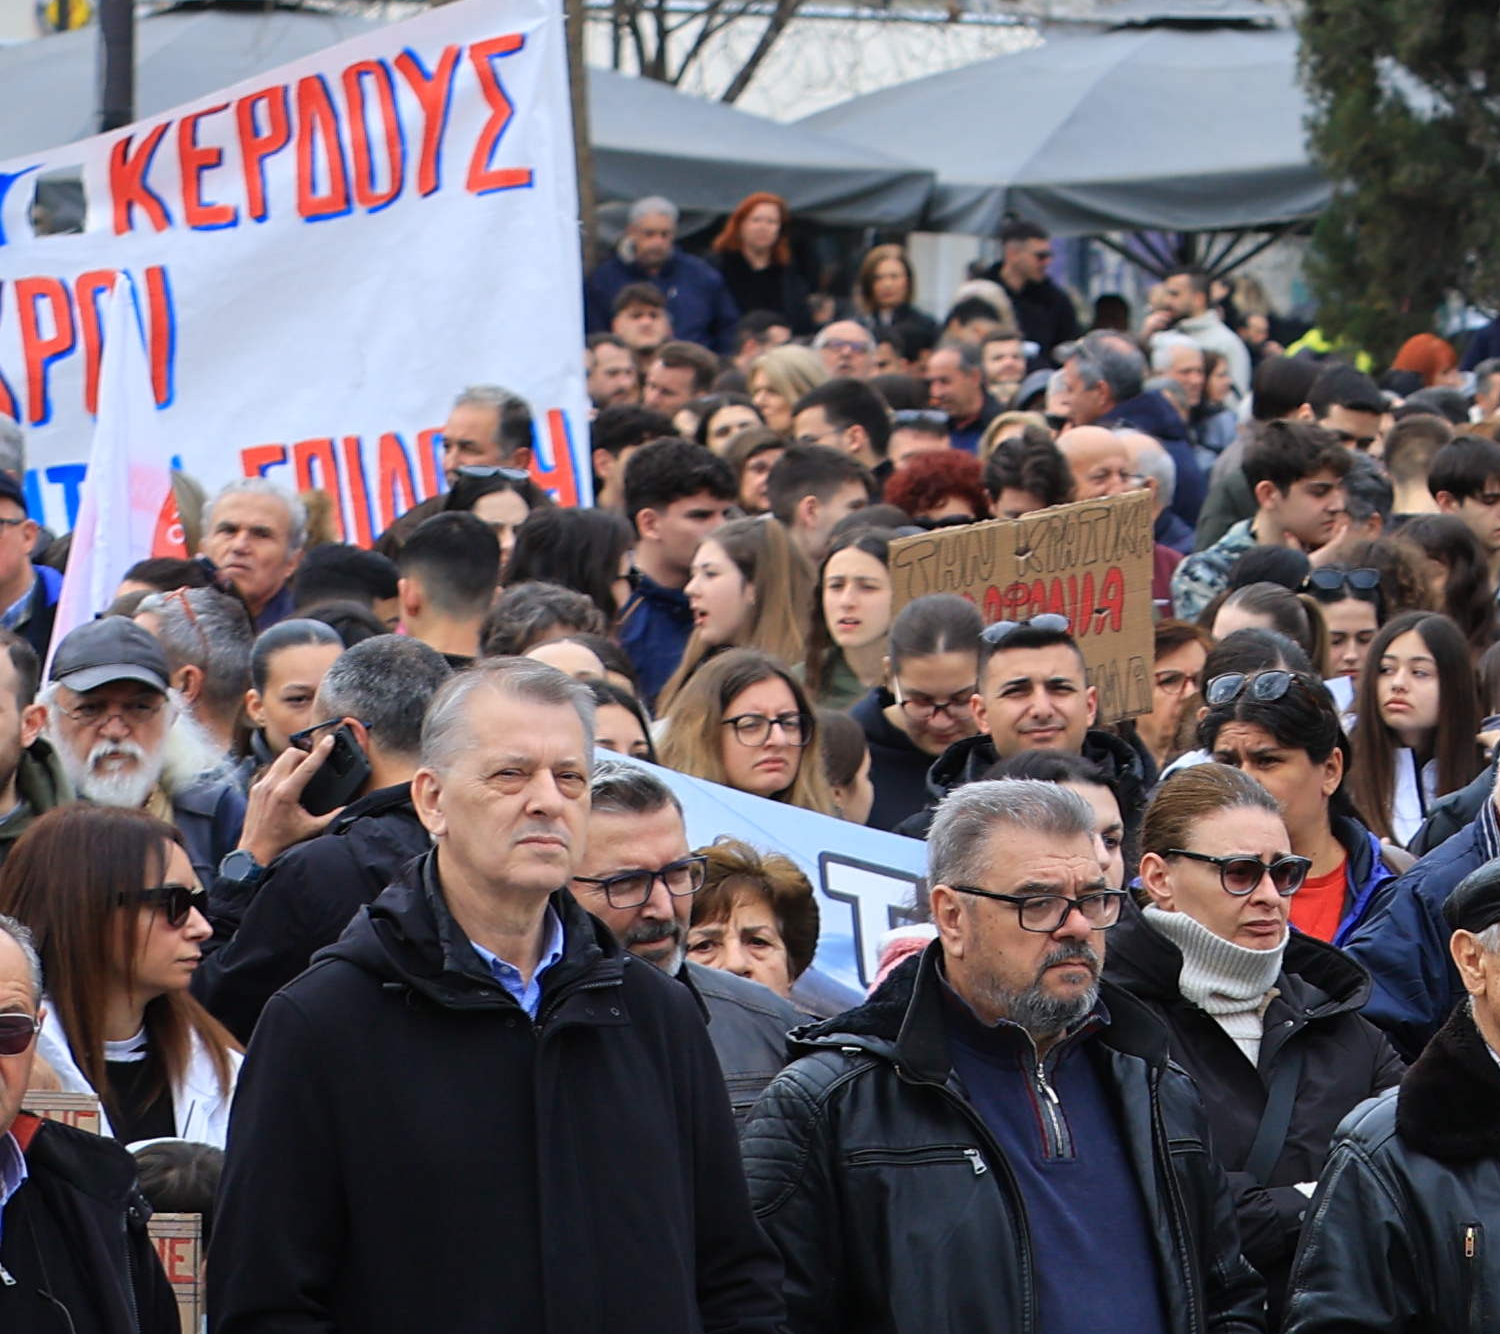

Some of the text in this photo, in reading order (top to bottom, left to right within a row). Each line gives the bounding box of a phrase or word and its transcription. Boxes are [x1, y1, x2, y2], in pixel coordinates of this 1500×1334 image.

[109, 34, 532, 235] ΚΕΡΔΟΥΣ
[896, 499, 1150, 599] ΤΗΝ ΚΡΑΤΙΚΗ
